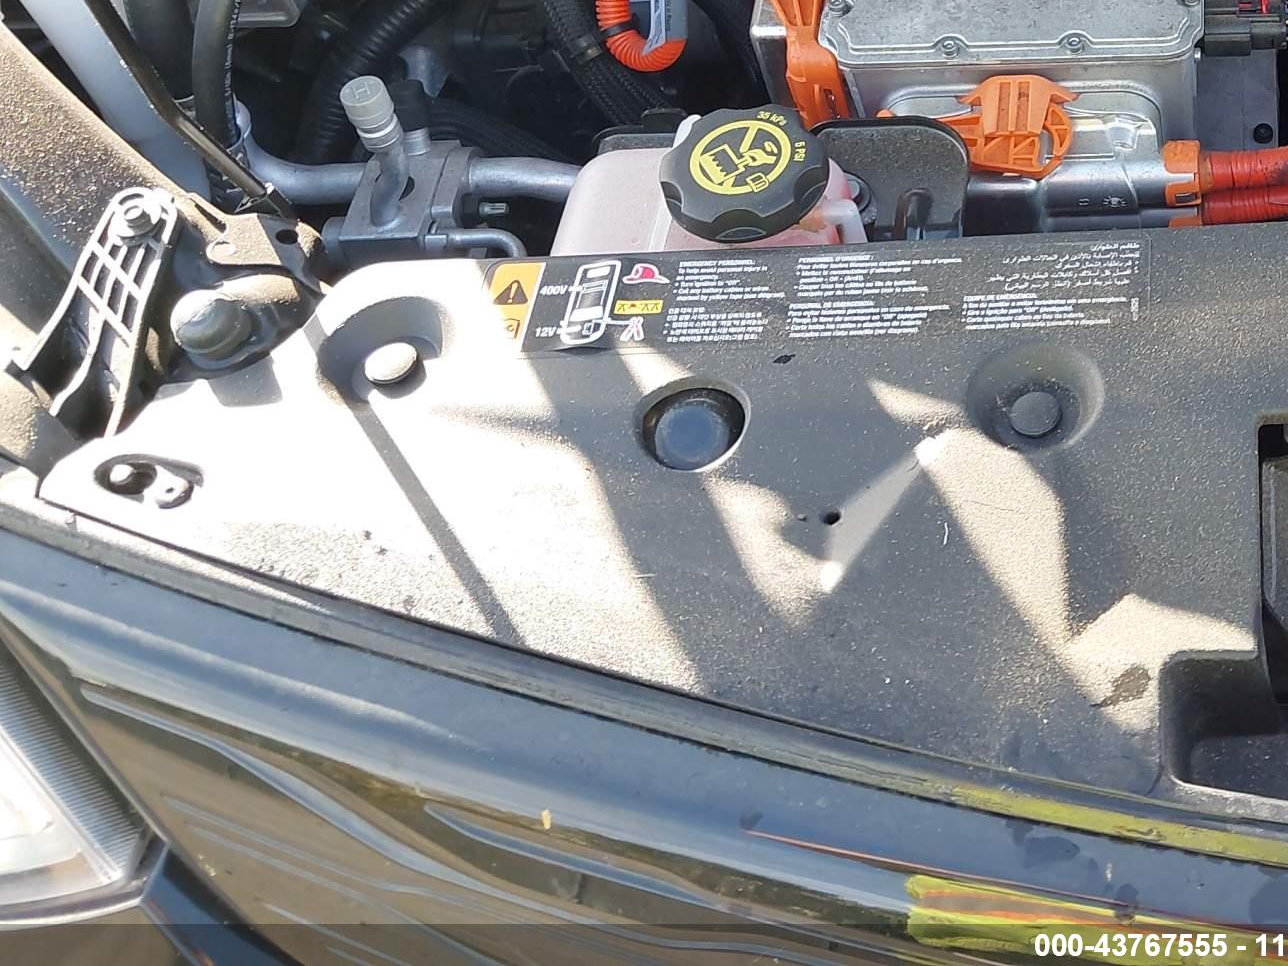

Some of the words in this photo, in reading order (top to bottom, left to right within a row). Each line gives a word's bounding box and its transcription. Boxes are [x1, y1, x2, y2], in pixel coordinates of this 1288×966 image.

[756, 110, 770, 120] 35
[769, 113, 787, 127] kPa
[793, 148, 807, 162] PSI
[539, 285, 568, 296] 400V
[535, 326, 556, 337] 12V
